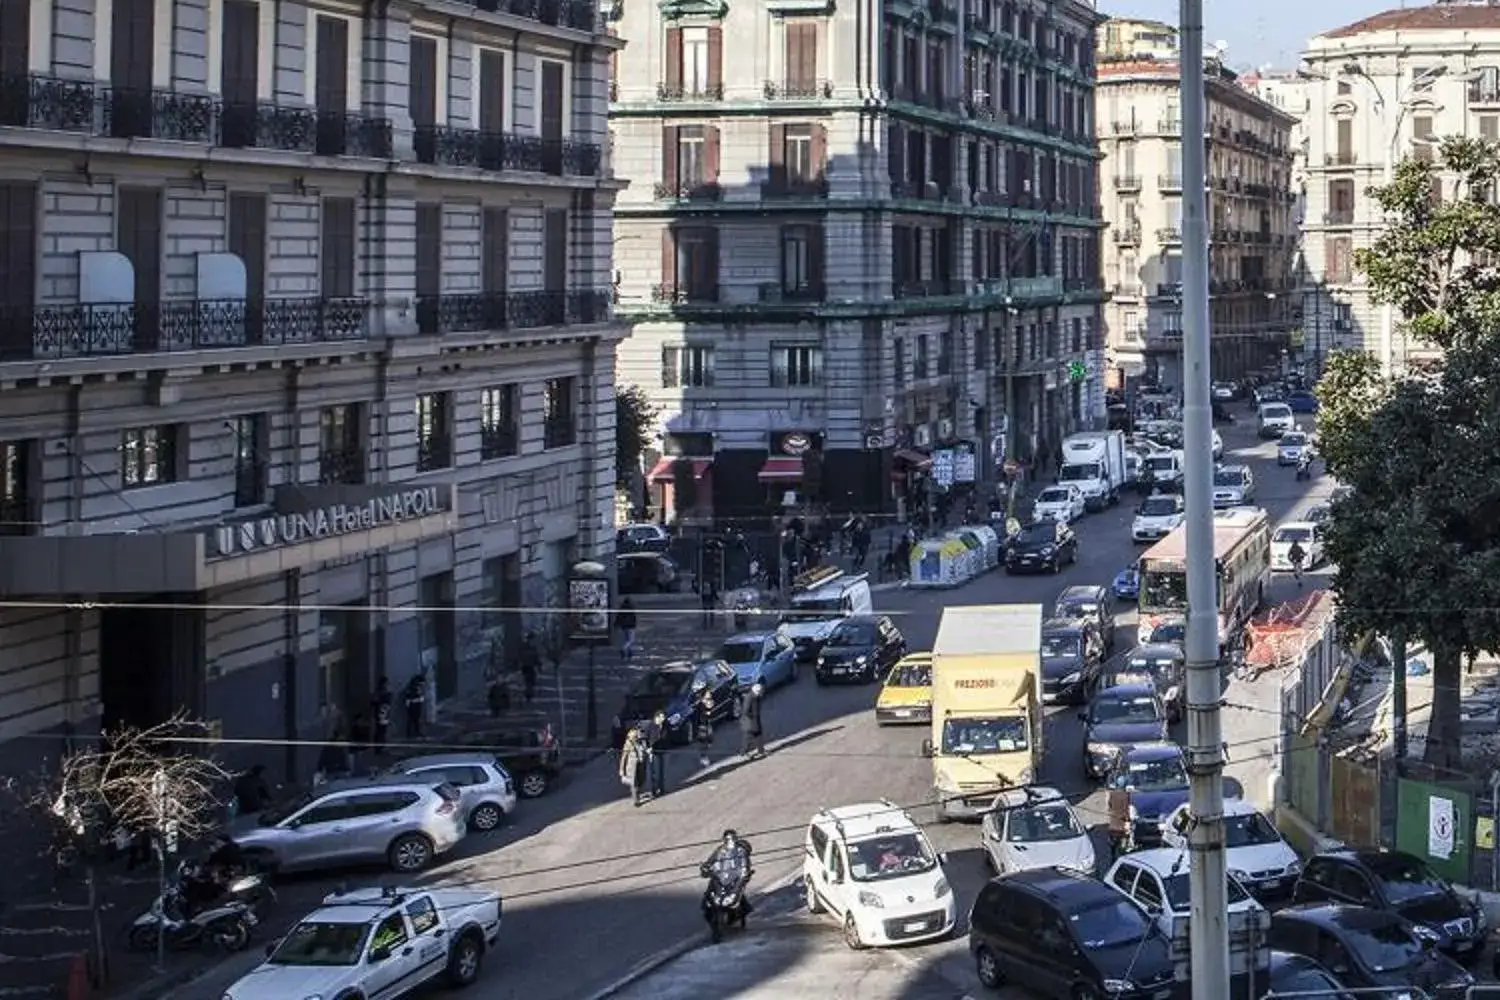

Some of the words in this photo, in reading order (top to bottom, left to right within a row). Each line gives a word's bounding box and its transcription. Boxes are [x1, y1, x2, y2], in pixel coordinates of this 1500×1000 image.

[282, 508, 329, 541] UNA
[333, 500, 376, 533] Hotel
[380, 487, 438, 521] NAPOLI
